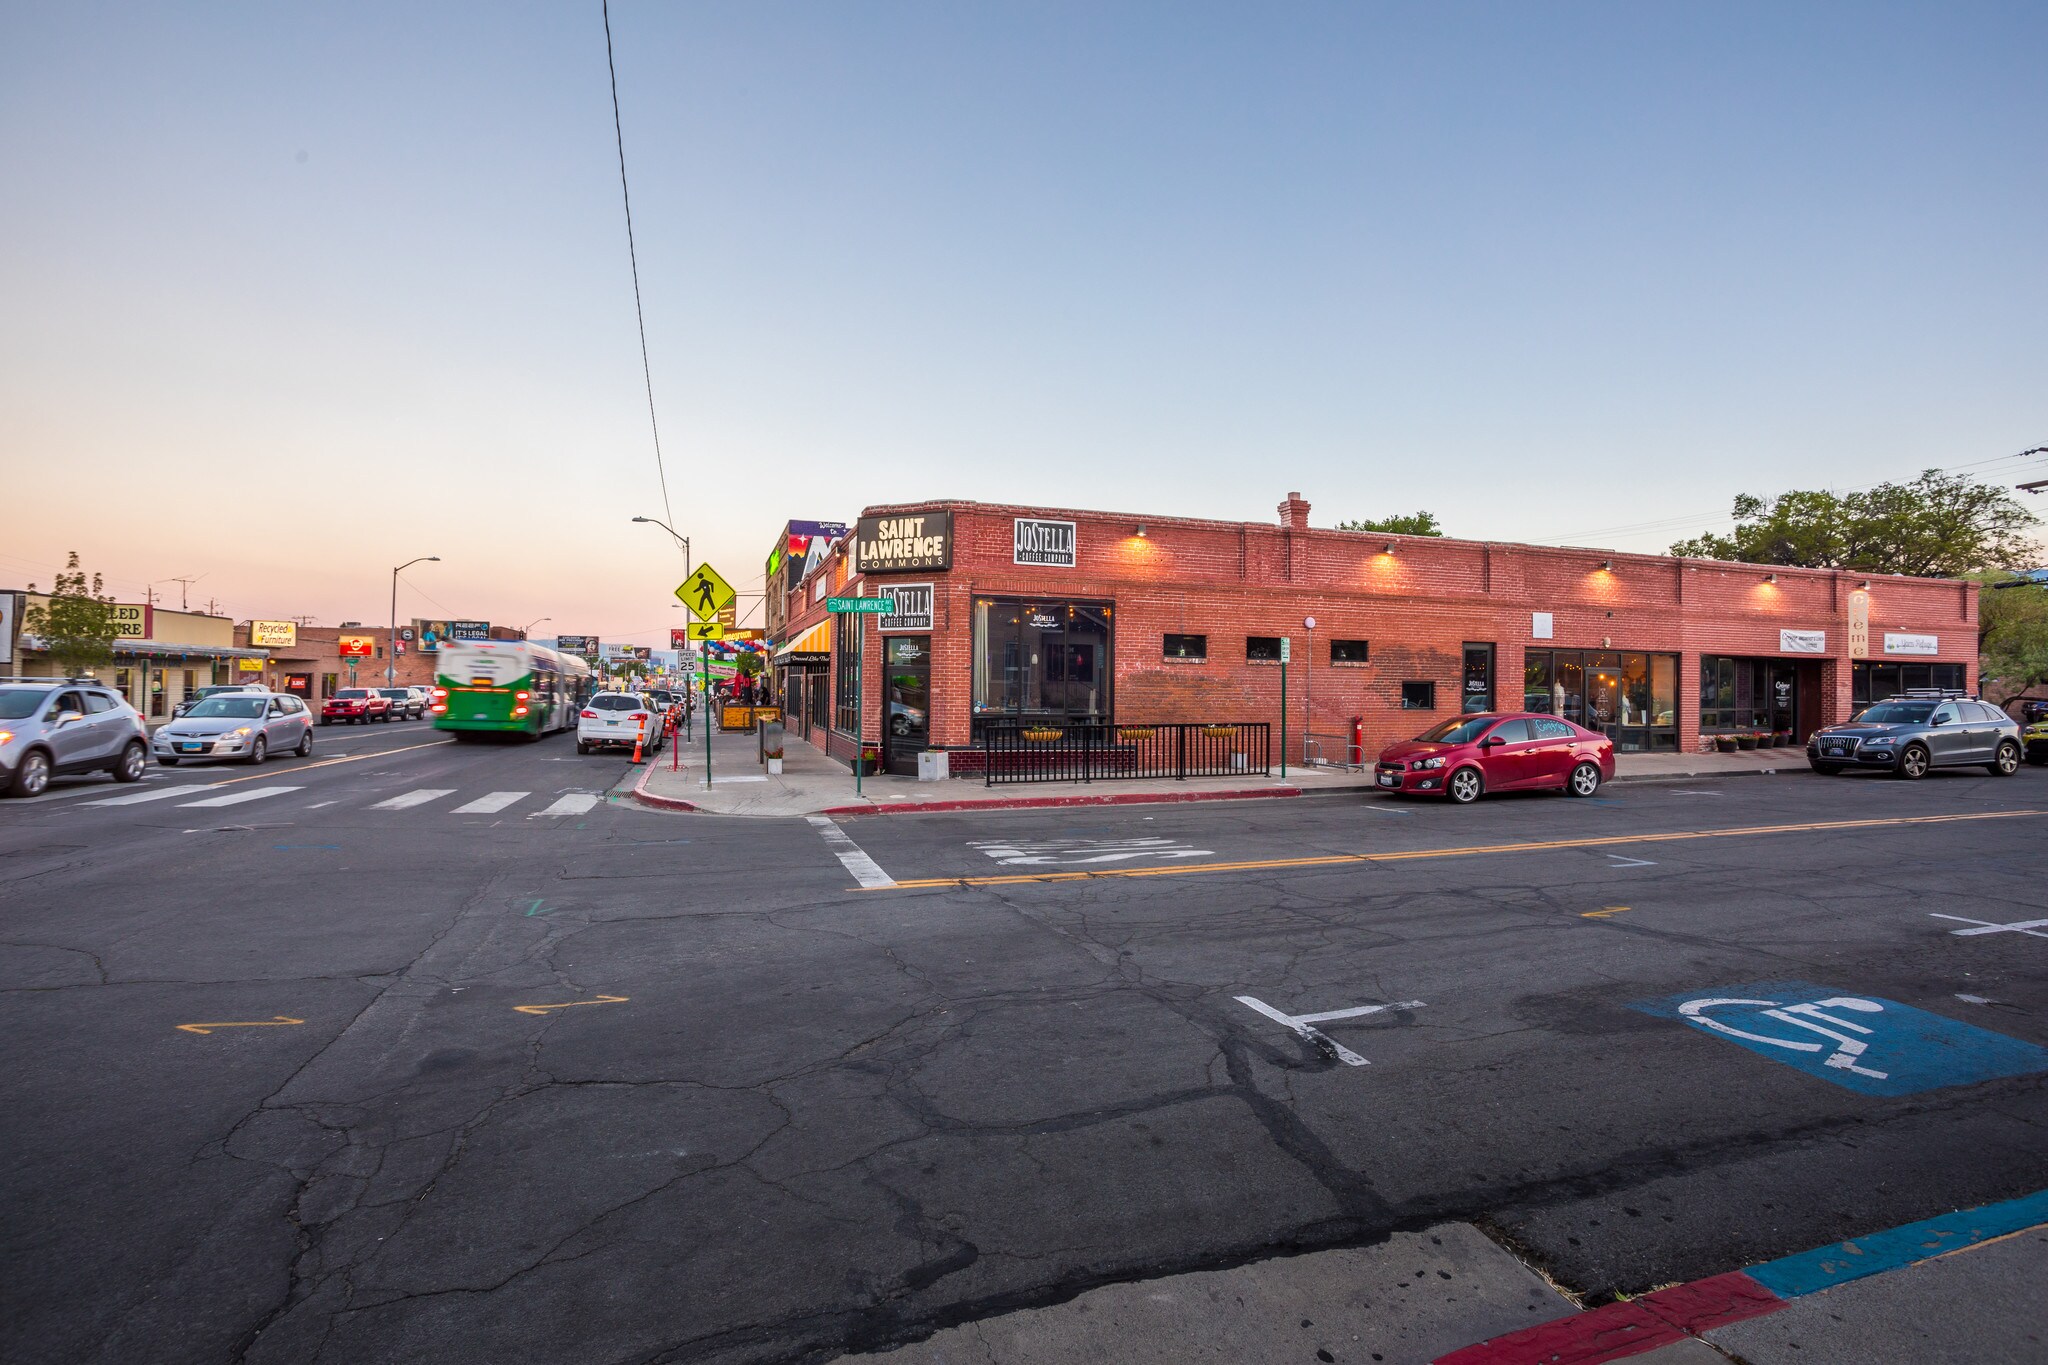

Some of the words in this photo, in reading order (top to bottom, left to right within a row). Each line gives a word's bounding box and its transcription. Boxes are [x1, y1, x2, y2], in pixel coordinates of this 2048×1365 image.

[879, 518, 924, 540] SAINT
[860, 536, 944, 560] LAWRENCE
[860, 557, 943, 569] COMMONS
[1022, 552, 1042, 562] COFFEE
[1044, 553, 1068, 563] COMPANY
[838, 599, 854, 611] SAINT
[855, 599, 884, 611] LAWRENCE
[885, 618, 902, 627] COFFEE
[904, 617, 927, 626] COMPANY
[258, 622, 289, 636] Recycled
[261, 635, 292, 644] Furniture
[723, 630, 752, 641] omegrown
[680, 661, 695, 671] 25
